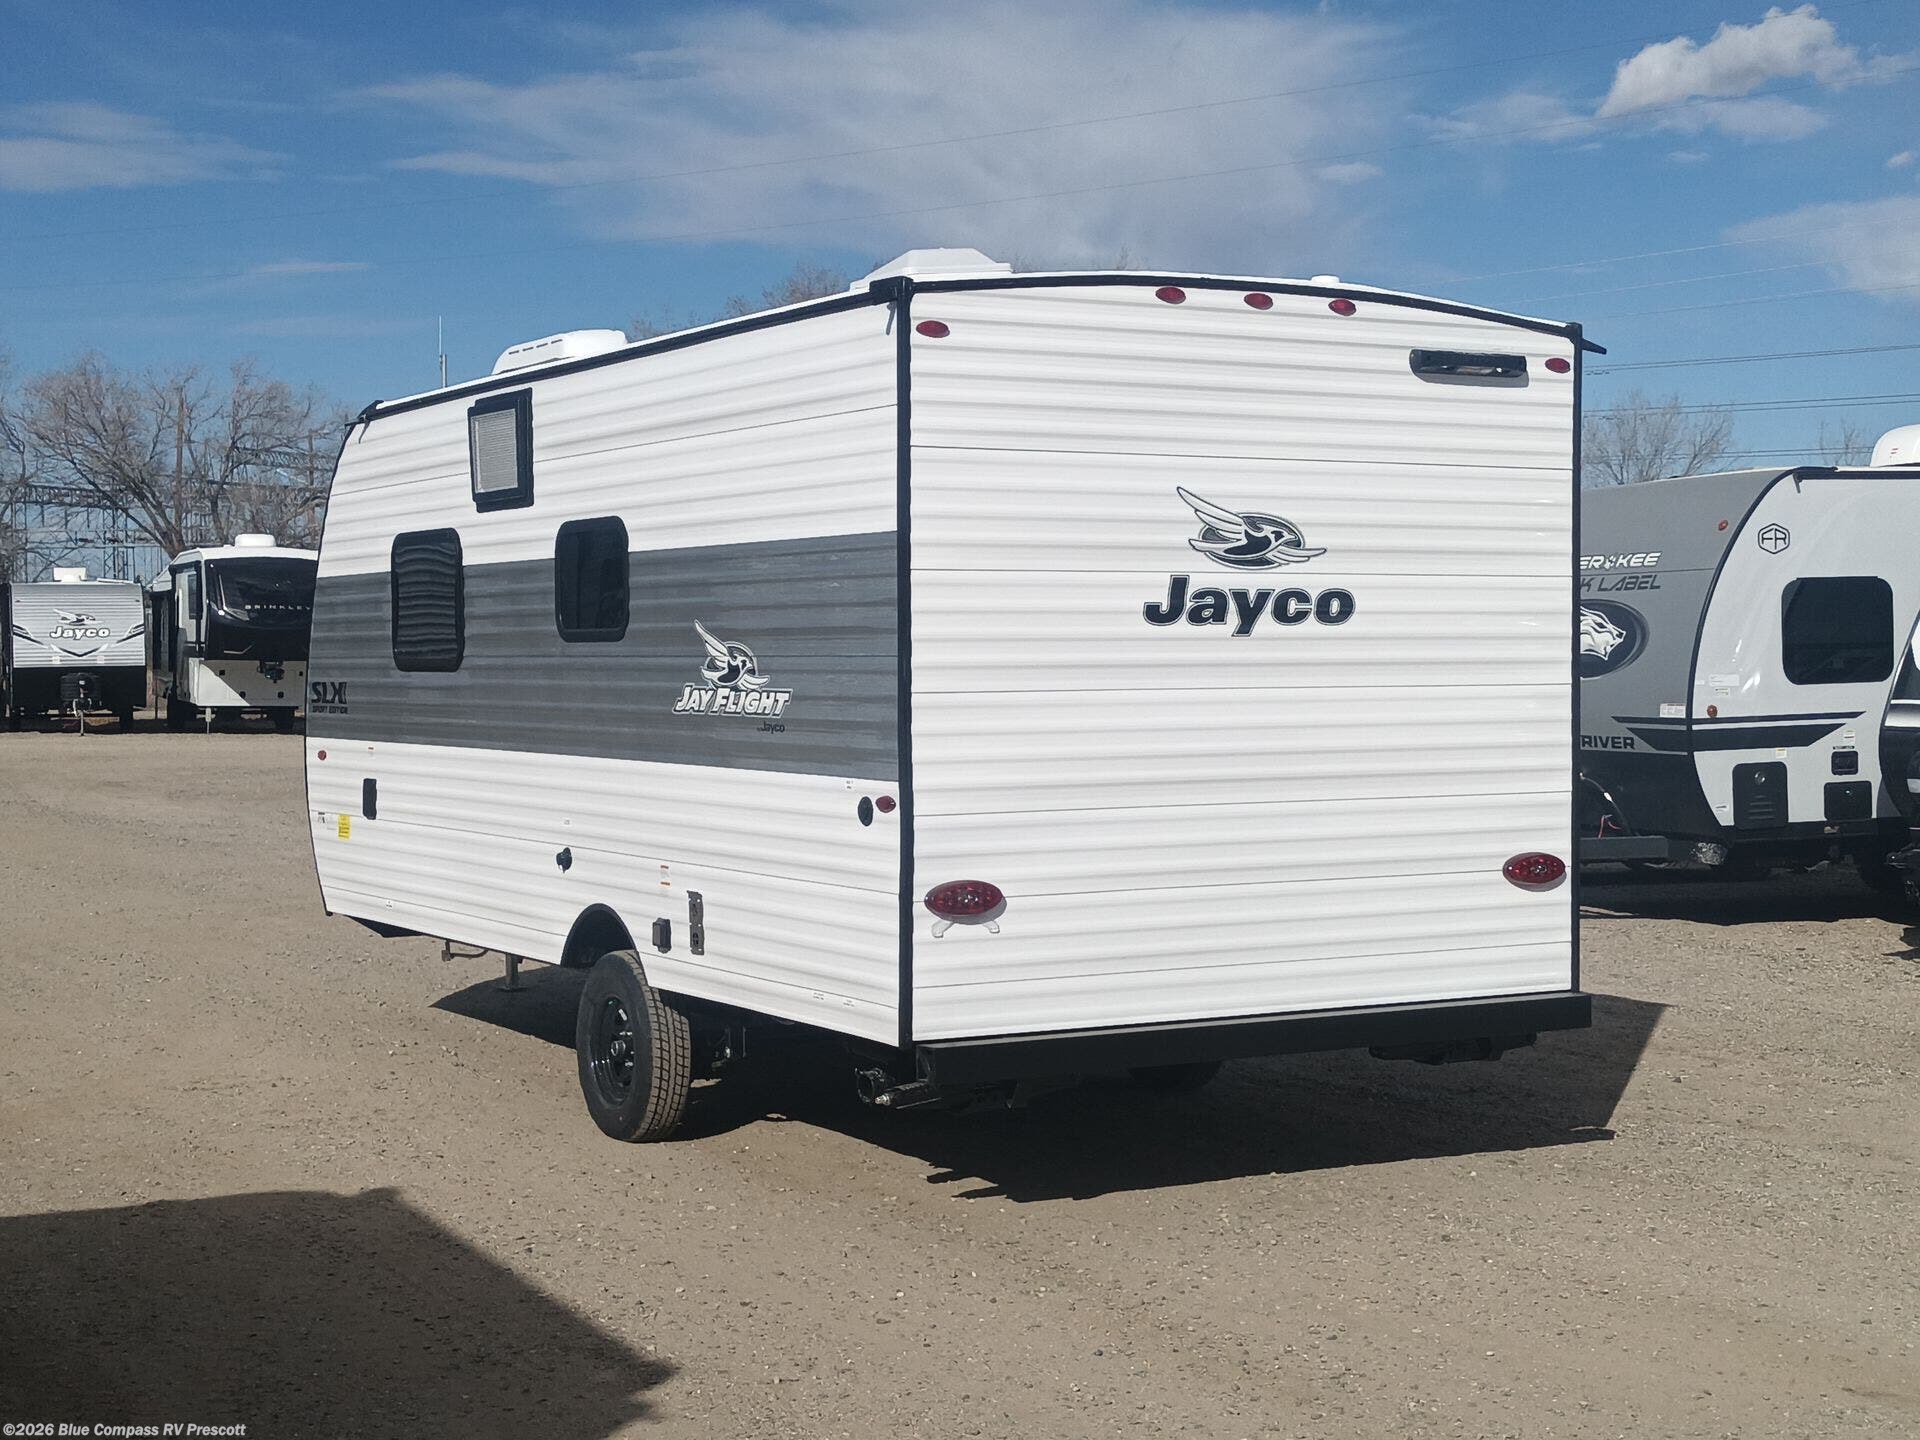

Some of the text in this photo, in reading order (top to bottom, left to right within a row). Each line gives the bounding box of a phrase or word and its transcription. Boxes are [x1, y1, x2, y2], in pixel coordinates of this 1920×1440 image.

[1598, 575, 1661, 592] LABEL
[1143, 574, 1356, 637] Jayco
[49, 626, 111, 641] Jayco
[673, 683, 793, 718] JAY FLIGHT
[762, 721, 786, 735] Jayco
[1581, 735, 1636, 750] RIVER
